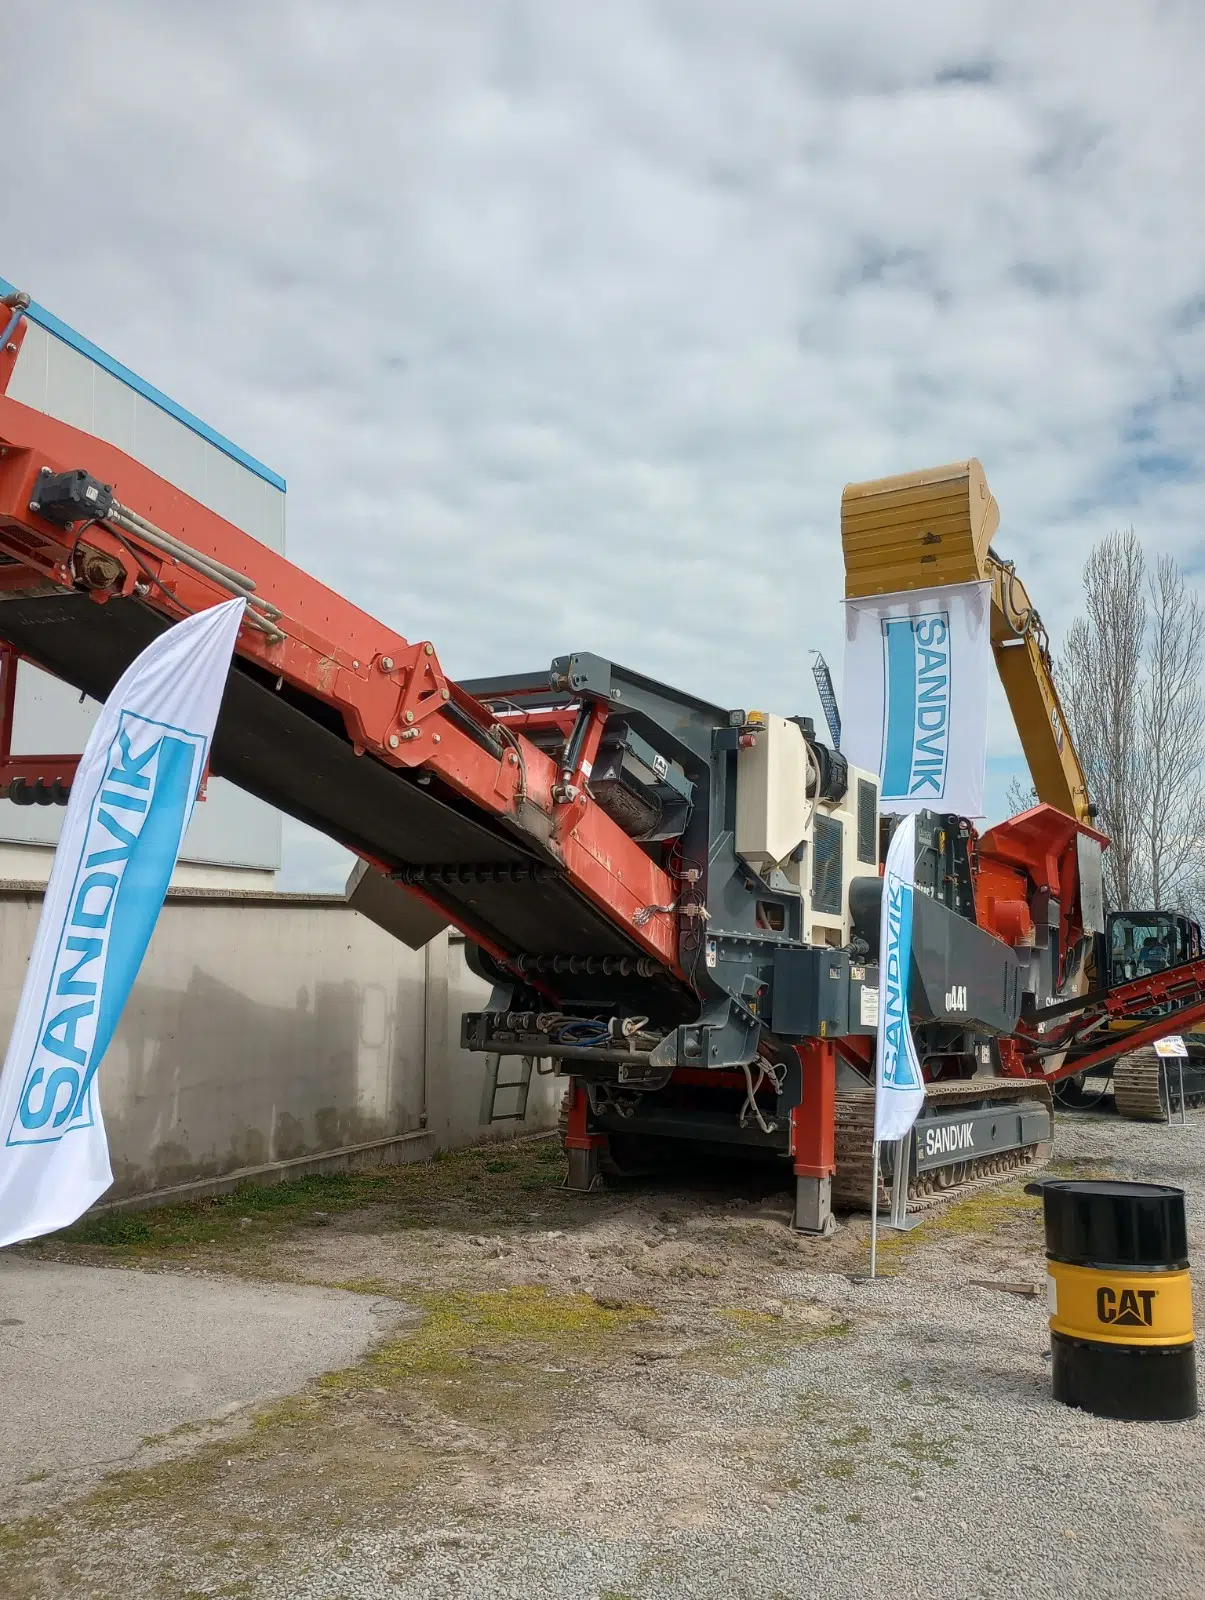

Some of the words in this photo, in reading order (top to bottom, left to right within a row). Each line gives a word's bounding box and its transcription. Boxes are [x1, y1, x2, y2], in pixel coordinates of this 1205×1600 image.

[911, 618, 947, 794] SANDVIK
[19, 728, 163, 1130] SANDVIK
[884, 882, 902, 1084] SANDVIK
[926, 1122, 975, 1156] SANDVIK
[1096, 1286, 1156, 1327] CAT
